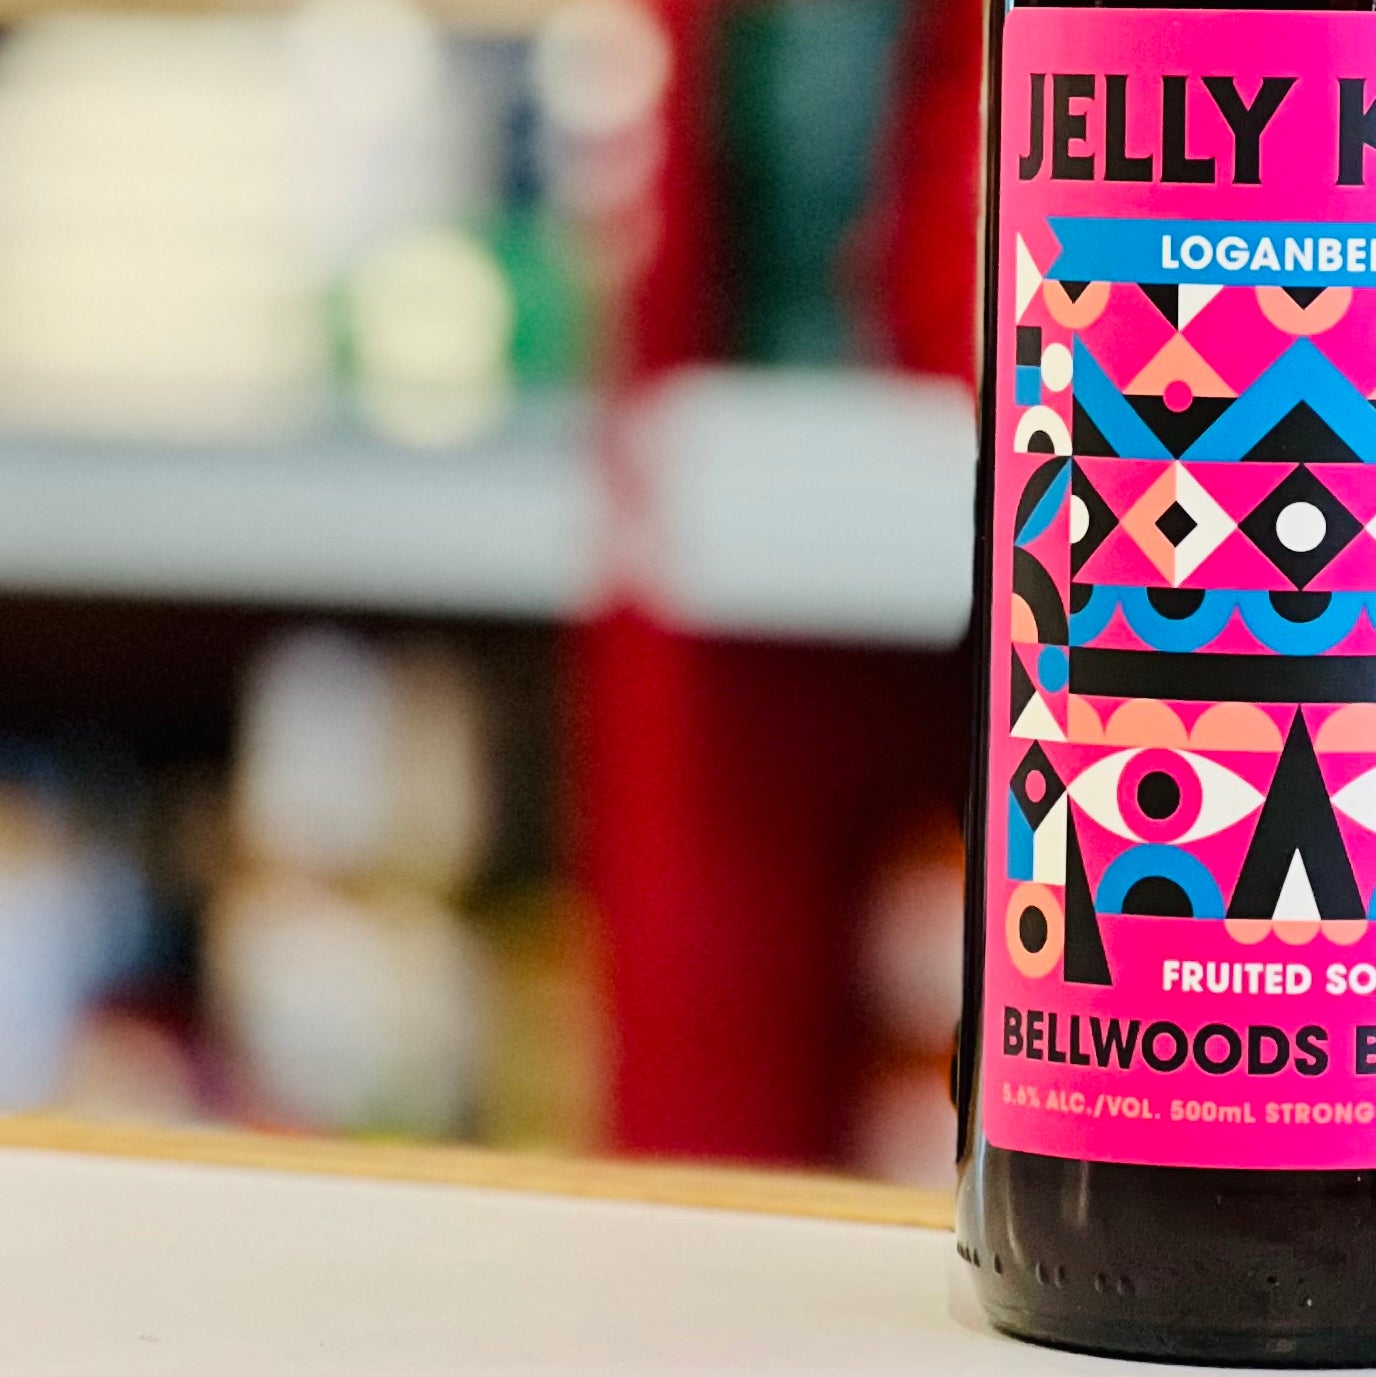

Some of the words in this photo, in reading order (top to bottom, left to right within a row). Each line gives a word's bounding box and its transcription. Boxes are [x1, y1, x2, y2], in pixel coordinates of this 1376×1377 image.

[1018, 72, 1299, 185] JELLY
[1162, 960, 1312, 995] FRUITED
[1003, 1006, 1330, 1077] BELLWOODS
[1170, 1100, 1256, 1124] 500mL
[1265, 1101, 1376, 1125] STRONG
